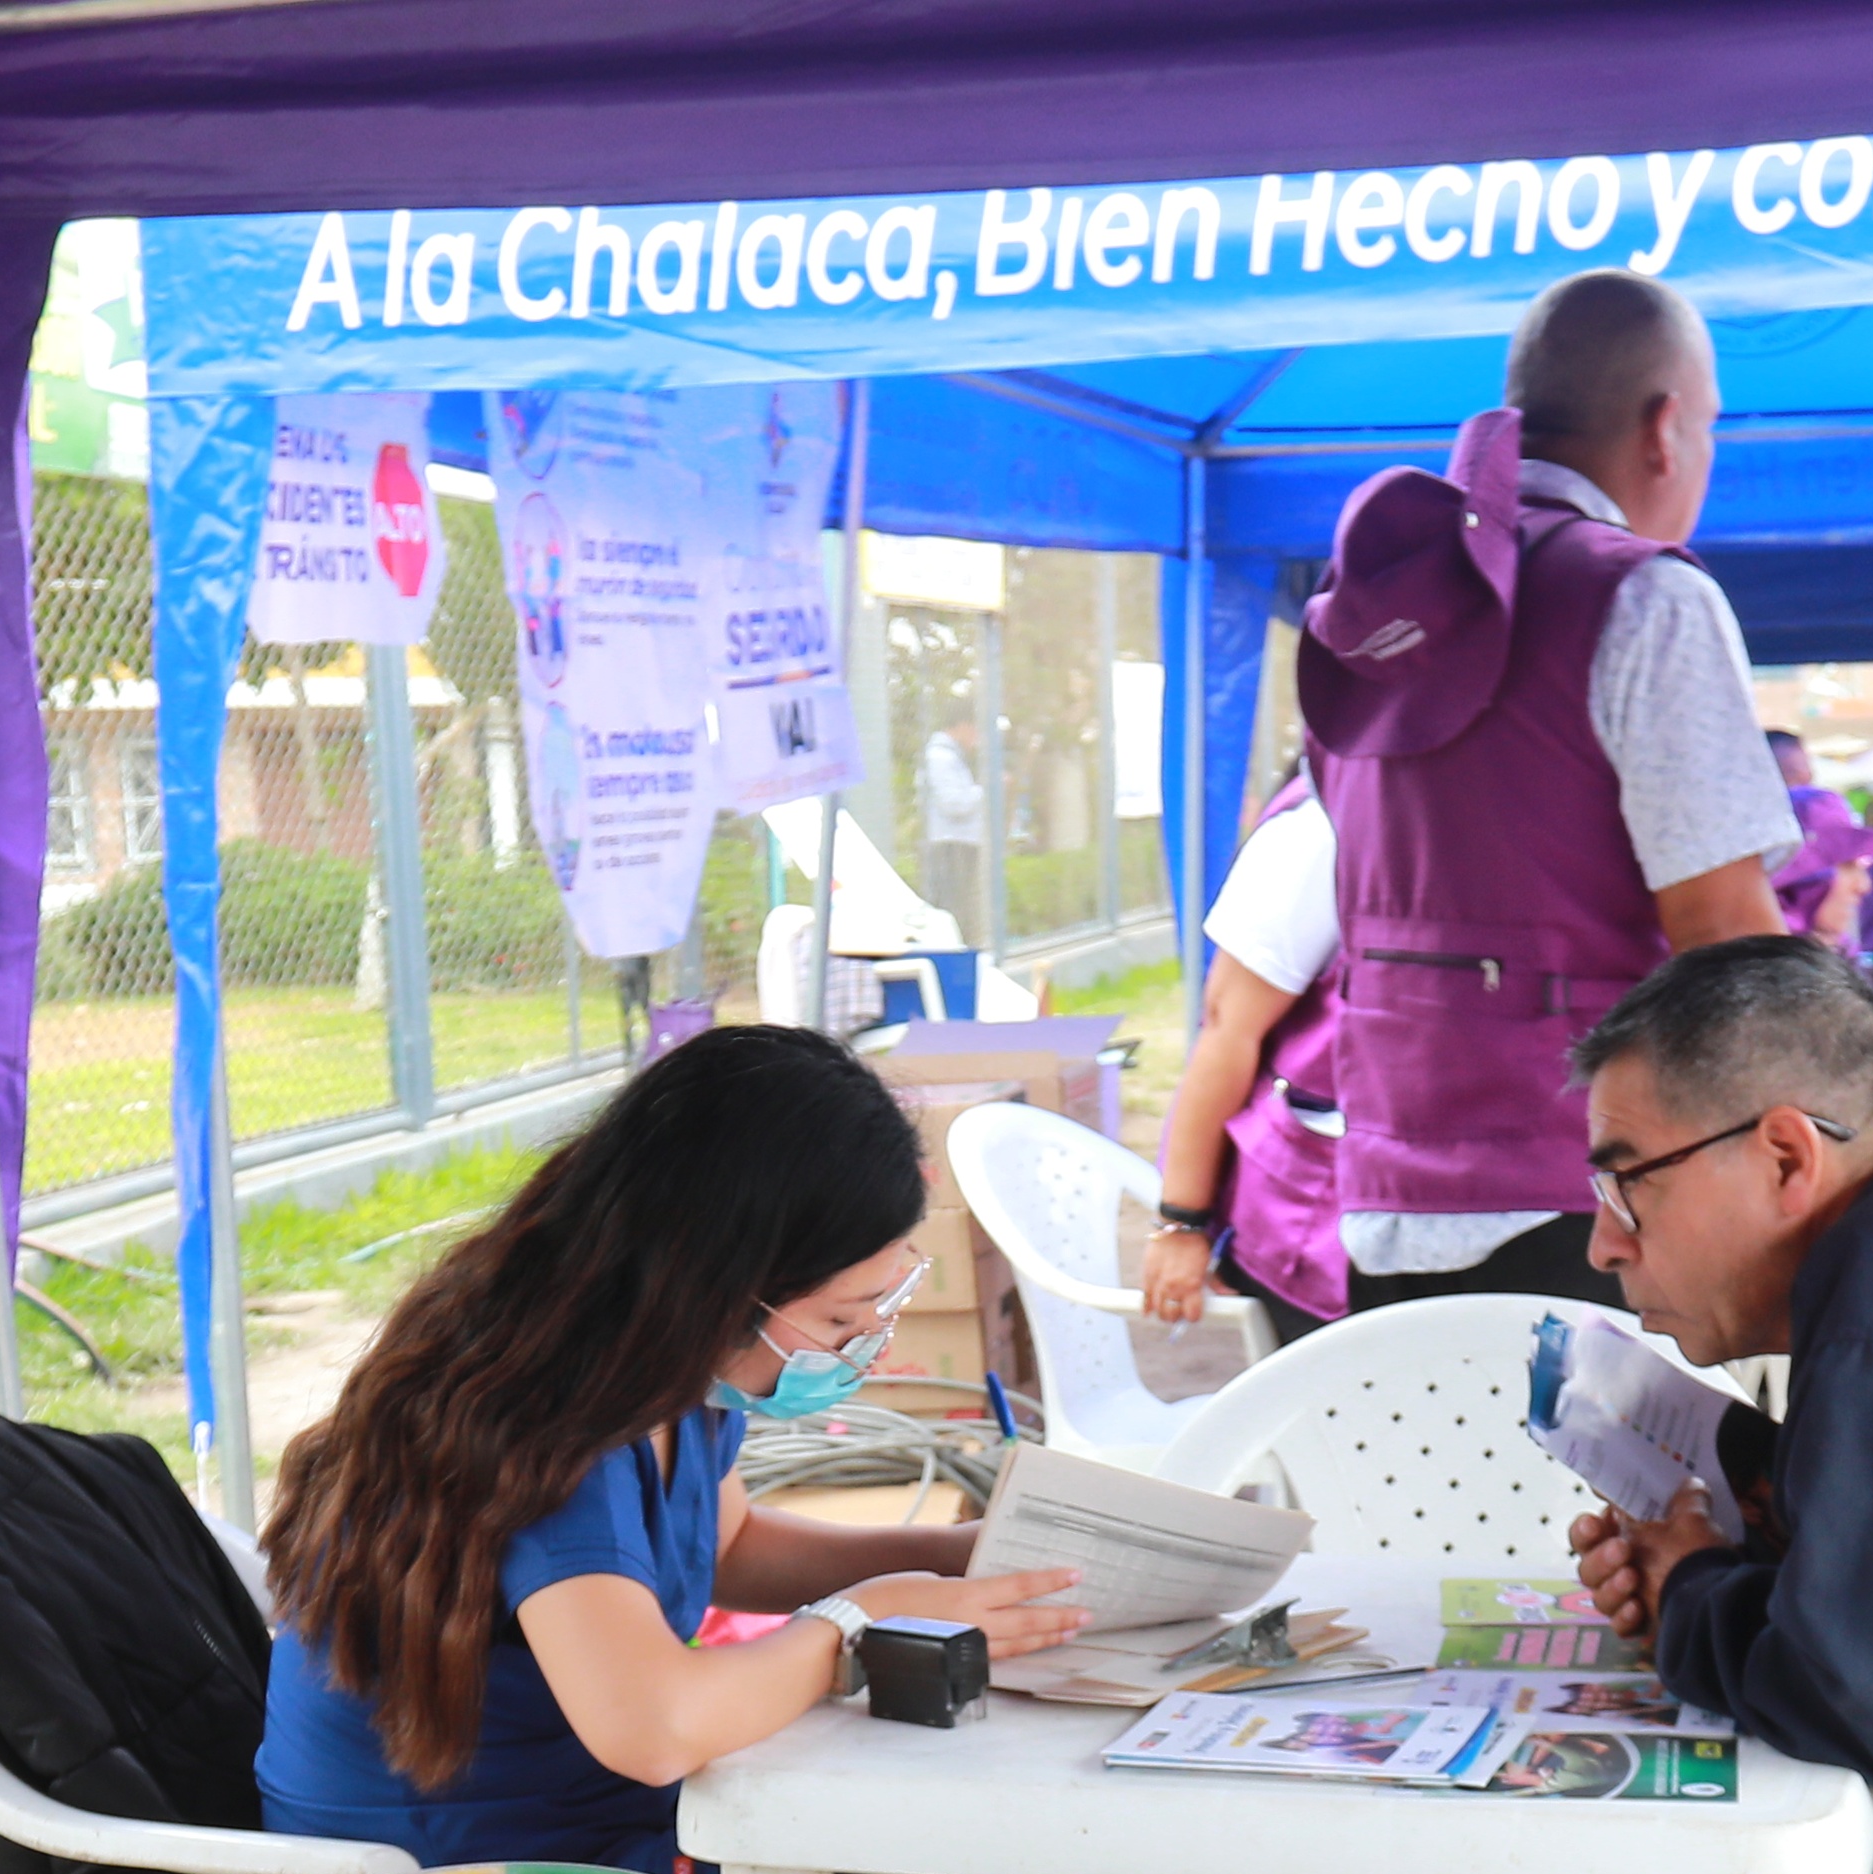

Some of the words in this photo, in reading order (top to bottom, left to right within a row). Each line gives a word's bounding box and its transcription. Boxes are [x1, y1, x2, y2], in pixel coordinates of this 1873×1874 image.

[287, 212, 361, 332] A
[383, 210, 475, 327] la
[498, 201, 955, 320] Chalaca,
[976, 189, 1216, 299] Bien
[1628, 150, 1713, 273] y
